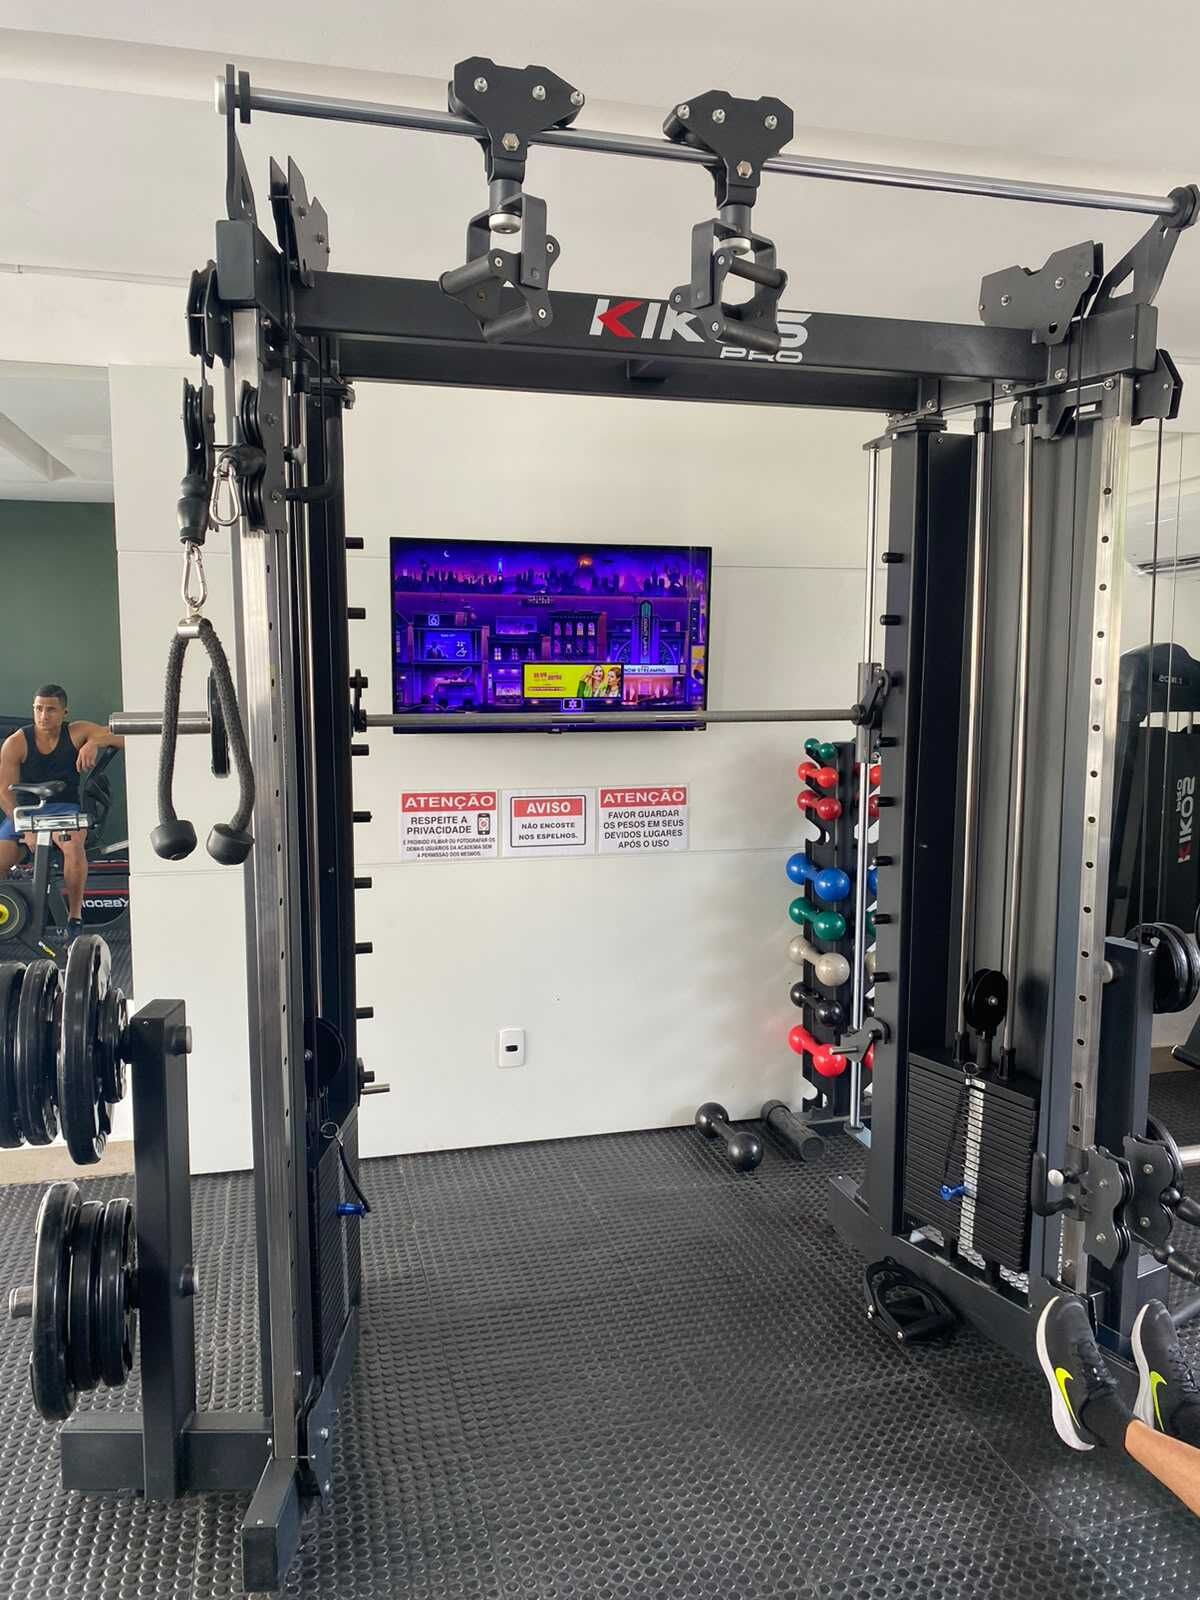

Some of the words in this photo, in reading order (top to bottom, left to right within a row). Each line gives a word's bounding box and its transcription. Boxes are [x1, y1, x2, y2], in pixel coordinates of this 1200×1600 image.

[589, 298, 812, 349] KIKS
[719, 346, 804, 363] PRO
[405, 794, 494, 809] ATENÇÃO
[603, 789, 684, 804] ATENÇÃO
[526, 802, 571, 814] AVISO
[638, 810, 679, 818] GUARDAR
[411, 816, 458, 824] RESPEITE
[407, 826, 472, 834] PRIVACIDADE
[618, 840, 641, 848] APÓS
